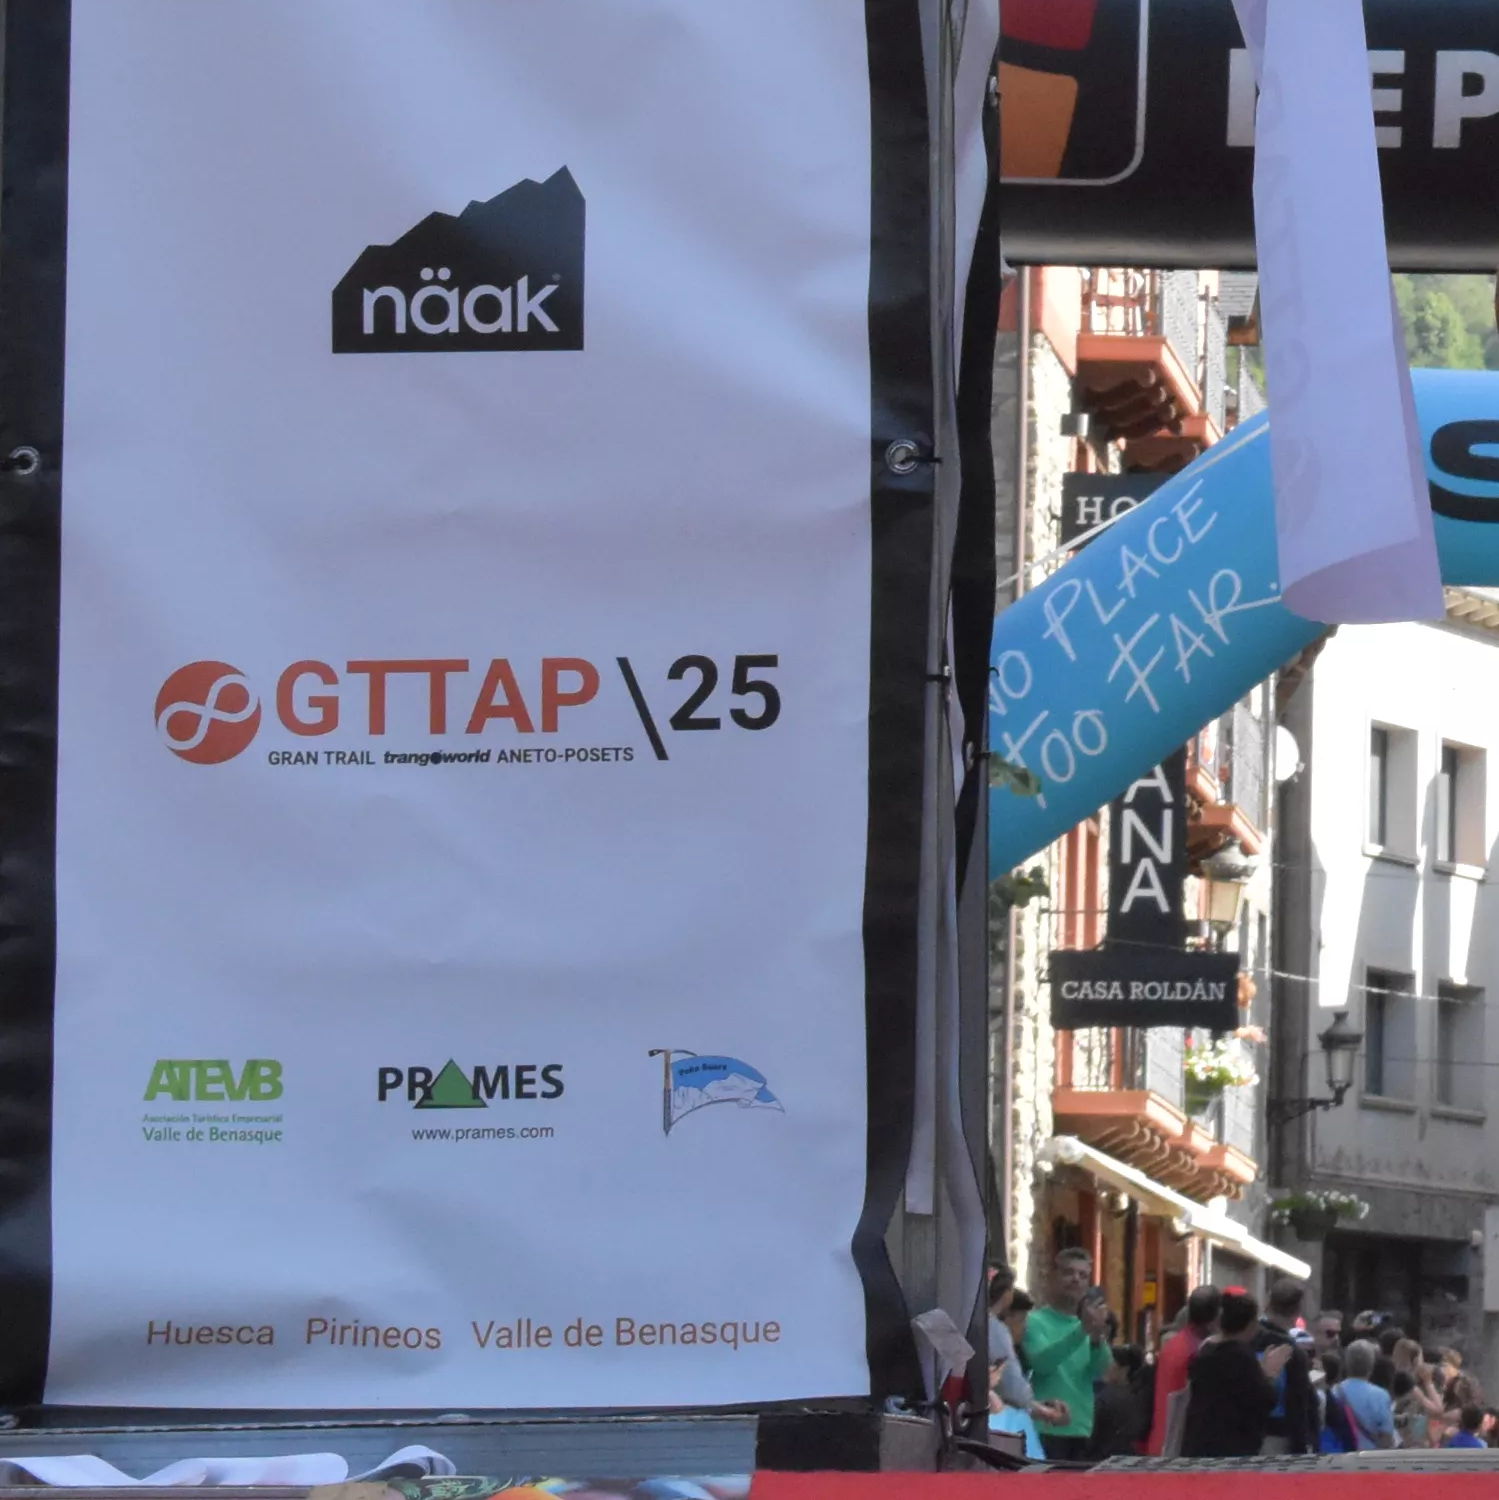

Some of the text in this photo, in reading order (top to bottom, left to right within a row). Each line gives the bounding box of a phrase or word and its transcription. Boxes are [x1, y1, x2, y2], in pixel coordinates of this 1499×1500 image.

[362, 268, 560, 334] näak
[1042, 479, 1218, 661] PLACE
[268, 749, 318, 765] GRAN
[324, 749, 375, 765] TRAIL
[496, 747, 634, 764] ANETO-POSETS
[1061, 980, 1124, 1000] CASA
[142, 1126, 283, 1145] Valle de Benasque
[412, 1125, 554, 1143] www.prames.com
[146, 1315, 781, 1354] Huesca Pirineos Valle de Benasque
